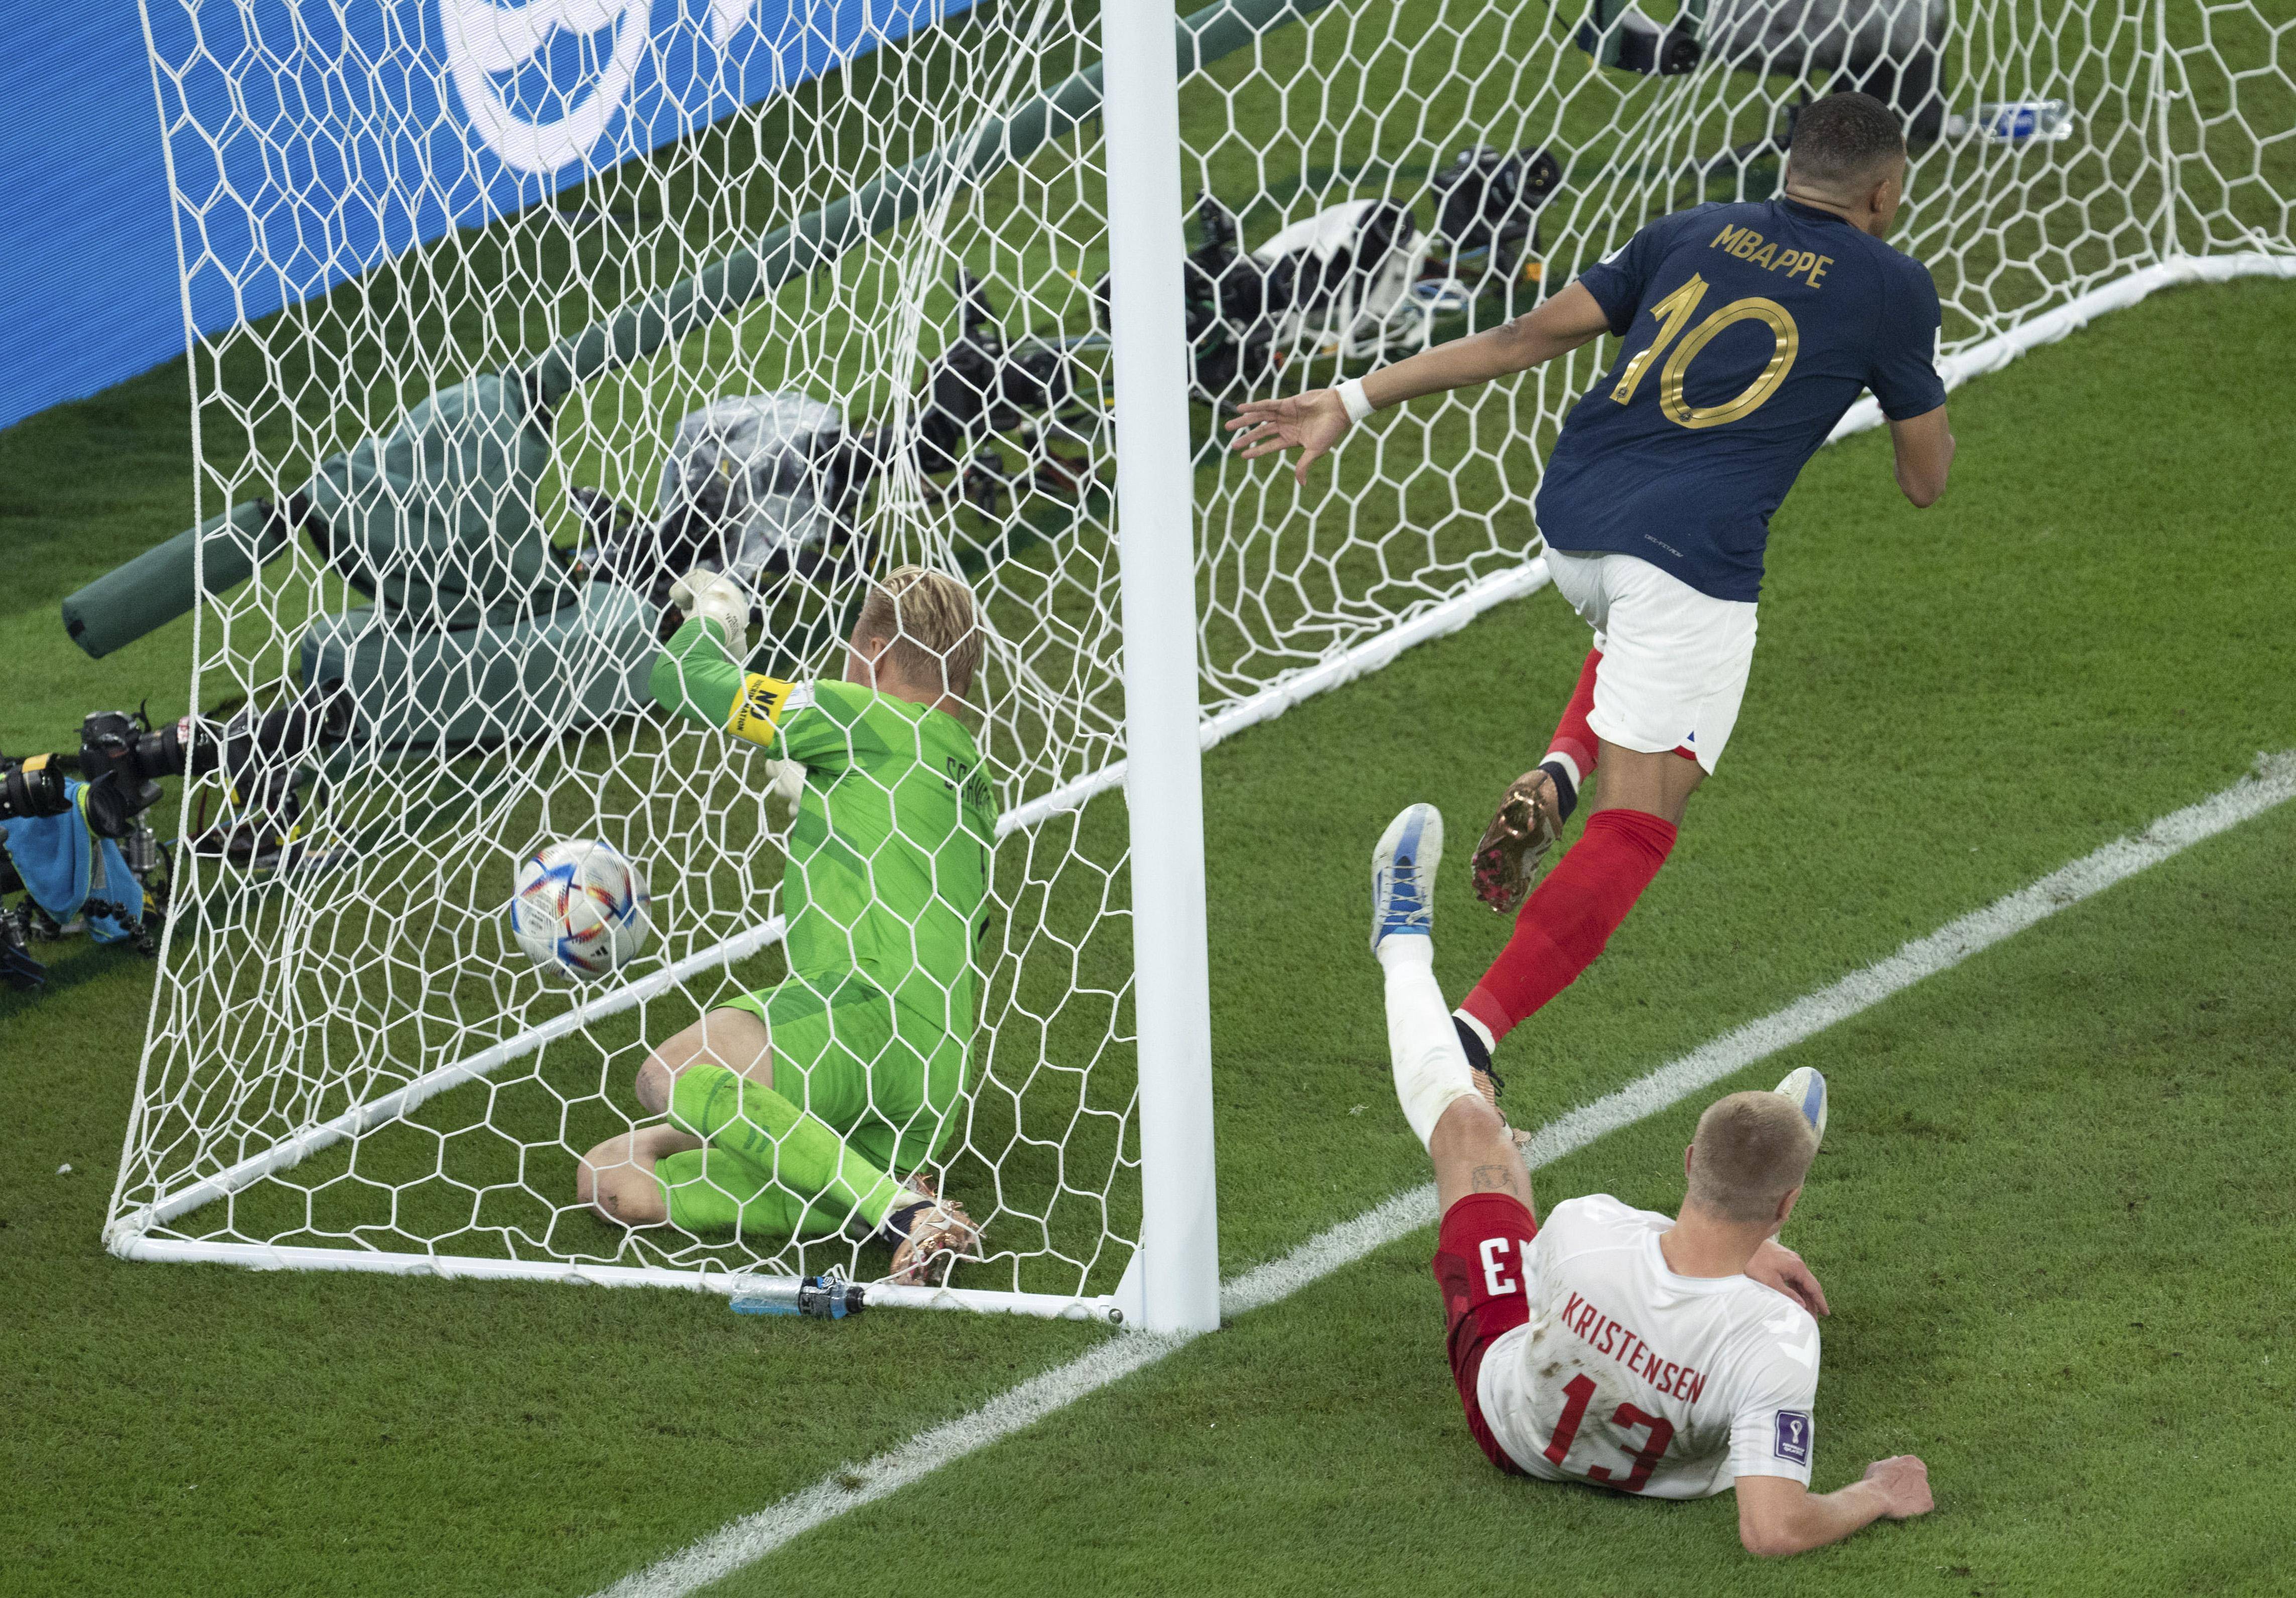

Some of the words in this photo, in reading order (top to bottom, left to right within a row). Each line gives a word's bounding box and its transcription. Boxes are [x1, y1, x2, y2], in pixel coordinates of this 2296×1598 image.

[1709, 224, 1834, 289] MBAPPE
[1609, 272, 1799, 429] 10
[737, 680, 764, 731] DISCRIMNATION
[750, 690, 778, 720] NO
[1561, 1291, 1706, 1404] KRISTENSEN
[1544, 1373, 1675, 1492] 13
